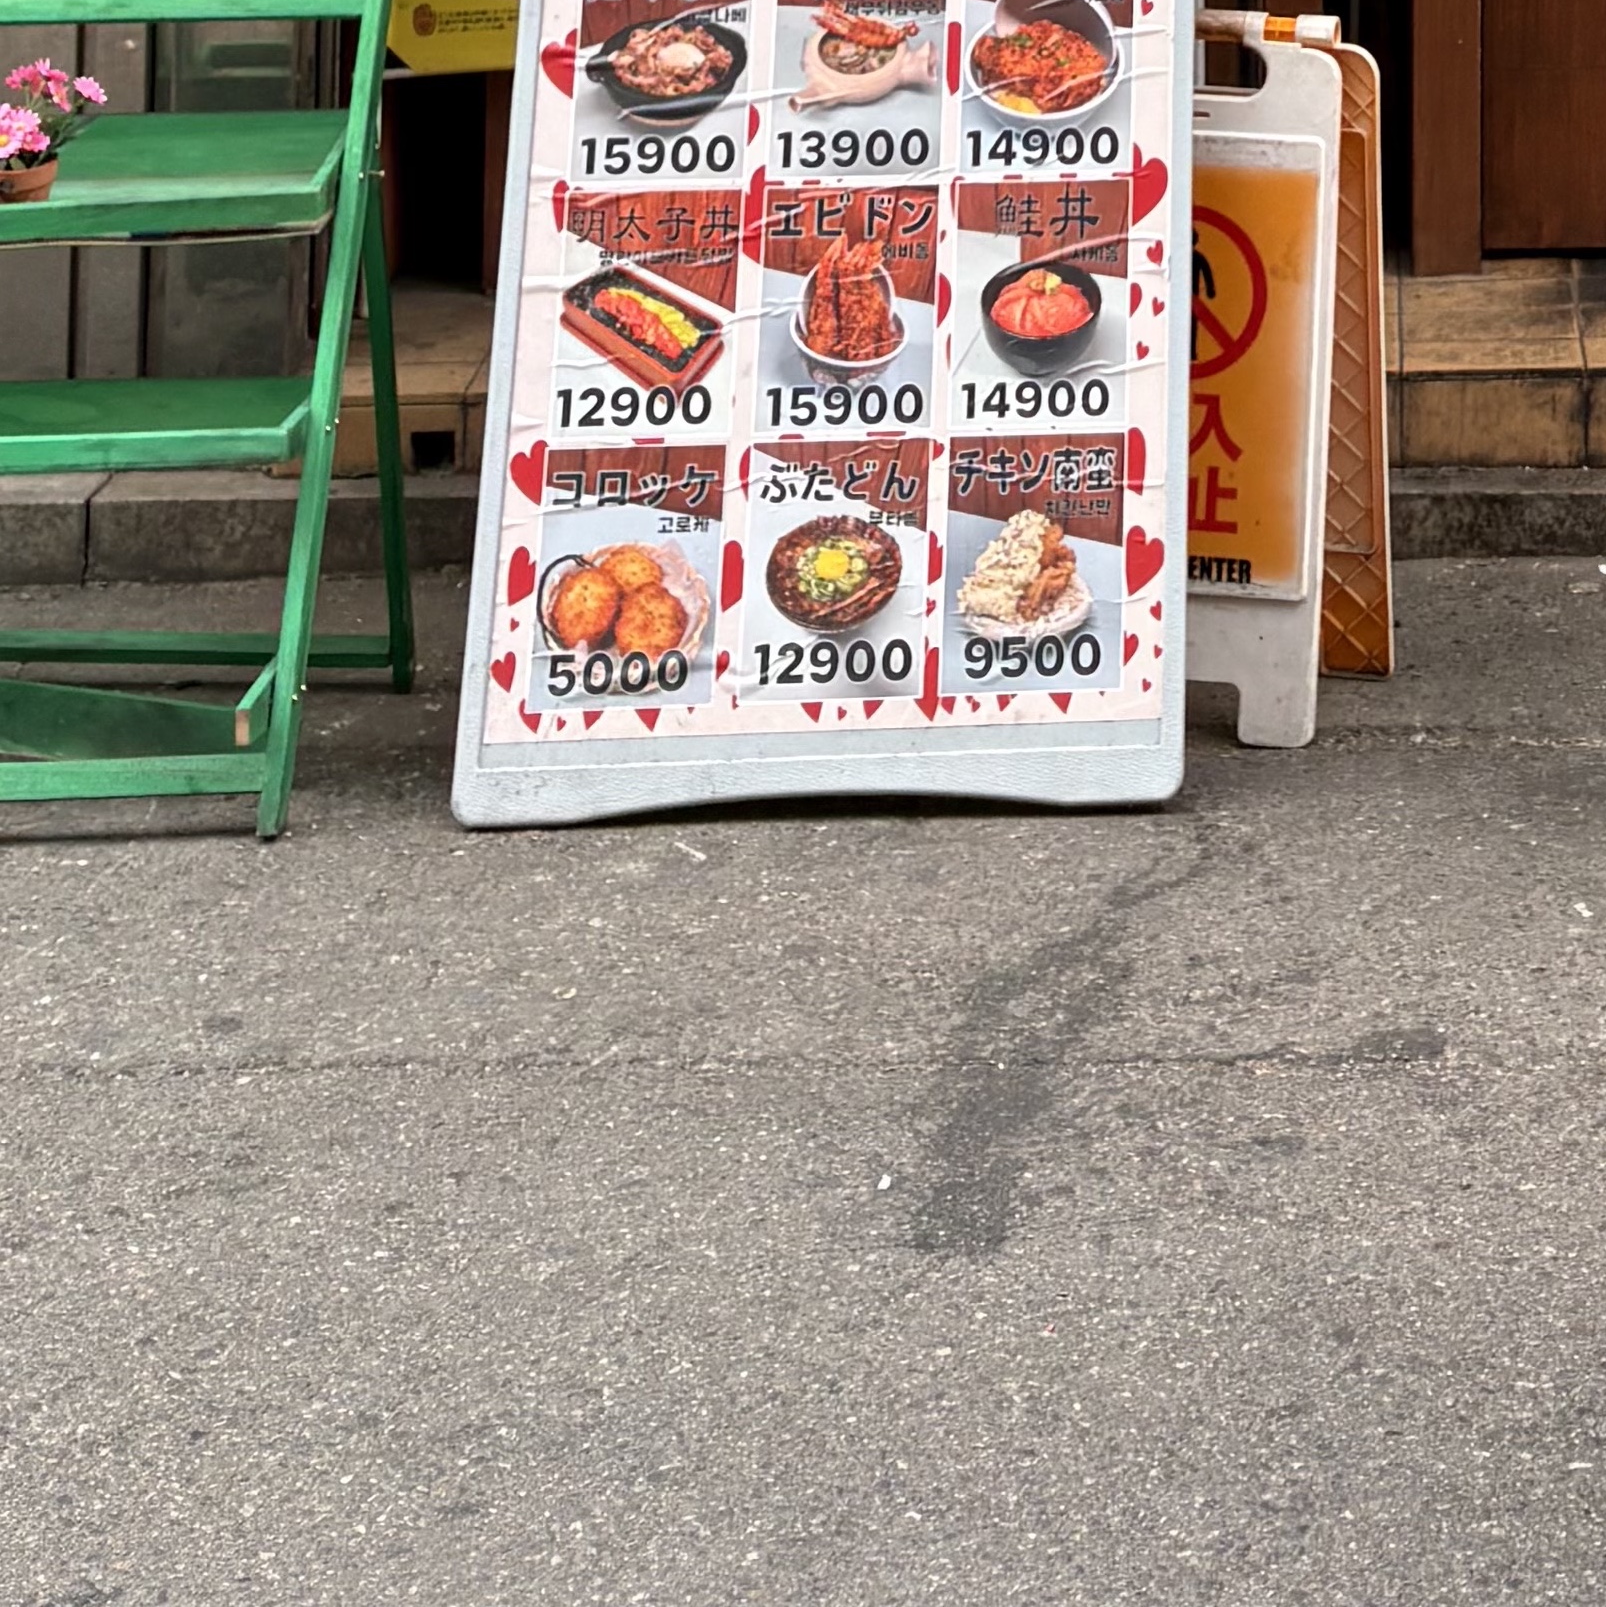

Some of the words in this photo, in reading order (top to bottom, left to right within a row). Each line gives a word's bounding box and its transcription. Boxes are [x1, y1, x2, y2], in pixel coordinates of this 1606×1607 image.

[578, 134, 737, 177] 15900
[776, 128, 931, 171] 13900
[964, 126, 1121, 167] 14900
[572, 205, 739, 243] 明太子丼
[770, 193, 933, 239] エビドン
[997, 188, 1100, 239] 鮭丼
[555, 385, 713, 430] 12900
[764, 382, 925, 428] 15900
[960, 378, 1112, 420] 14900
[552, 464, 717, 509] コロッケ
[760, 461, 920, 504] ぶたどん
[953, 445, 1117, 495] チキン南蛮
[547, 648, 690, 698] 5000
[754, 639, 914, 687] 12900
[963, 633, 1103, 681] 9500
